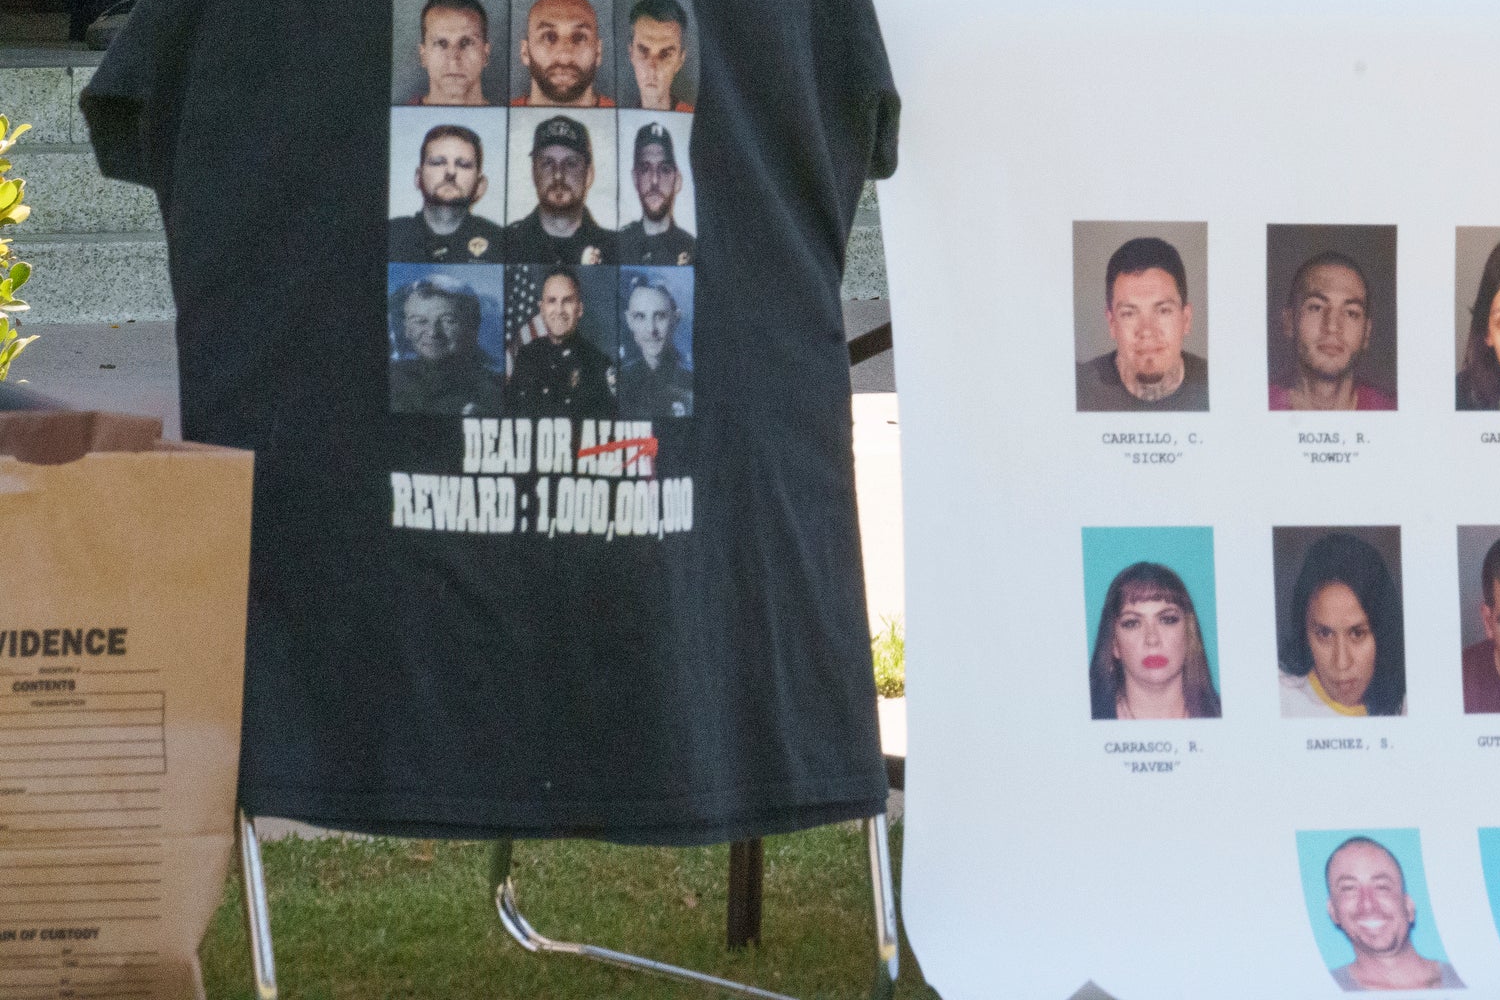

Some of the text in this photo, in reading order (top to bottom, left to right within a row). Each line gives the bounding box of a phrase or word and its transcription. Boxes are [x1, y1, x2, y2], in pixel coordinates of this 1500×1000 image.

[462, 418, 532, 474] DEAD
[536, 417, 573, 474] OR
[1101, 432, 1204, 447] CARRILLO, C.
[1298, 432, 1371, 446] ROJAS, R.
[1124, 451, 1184, 465] "SICKO"
[1303, 451, 1360, 465] "ROWDY"
[391, 472, 516, 533] REWARD
[0, 627, 128, 658] IDENCE
[12, 678, 76, 692] CONTENTS
[1103, 740, 1204, 756] CARRASCO, R.
[1306, 737, 1395, 752] SANCHEZ, S.
[20, 928, 37, 941] OF
